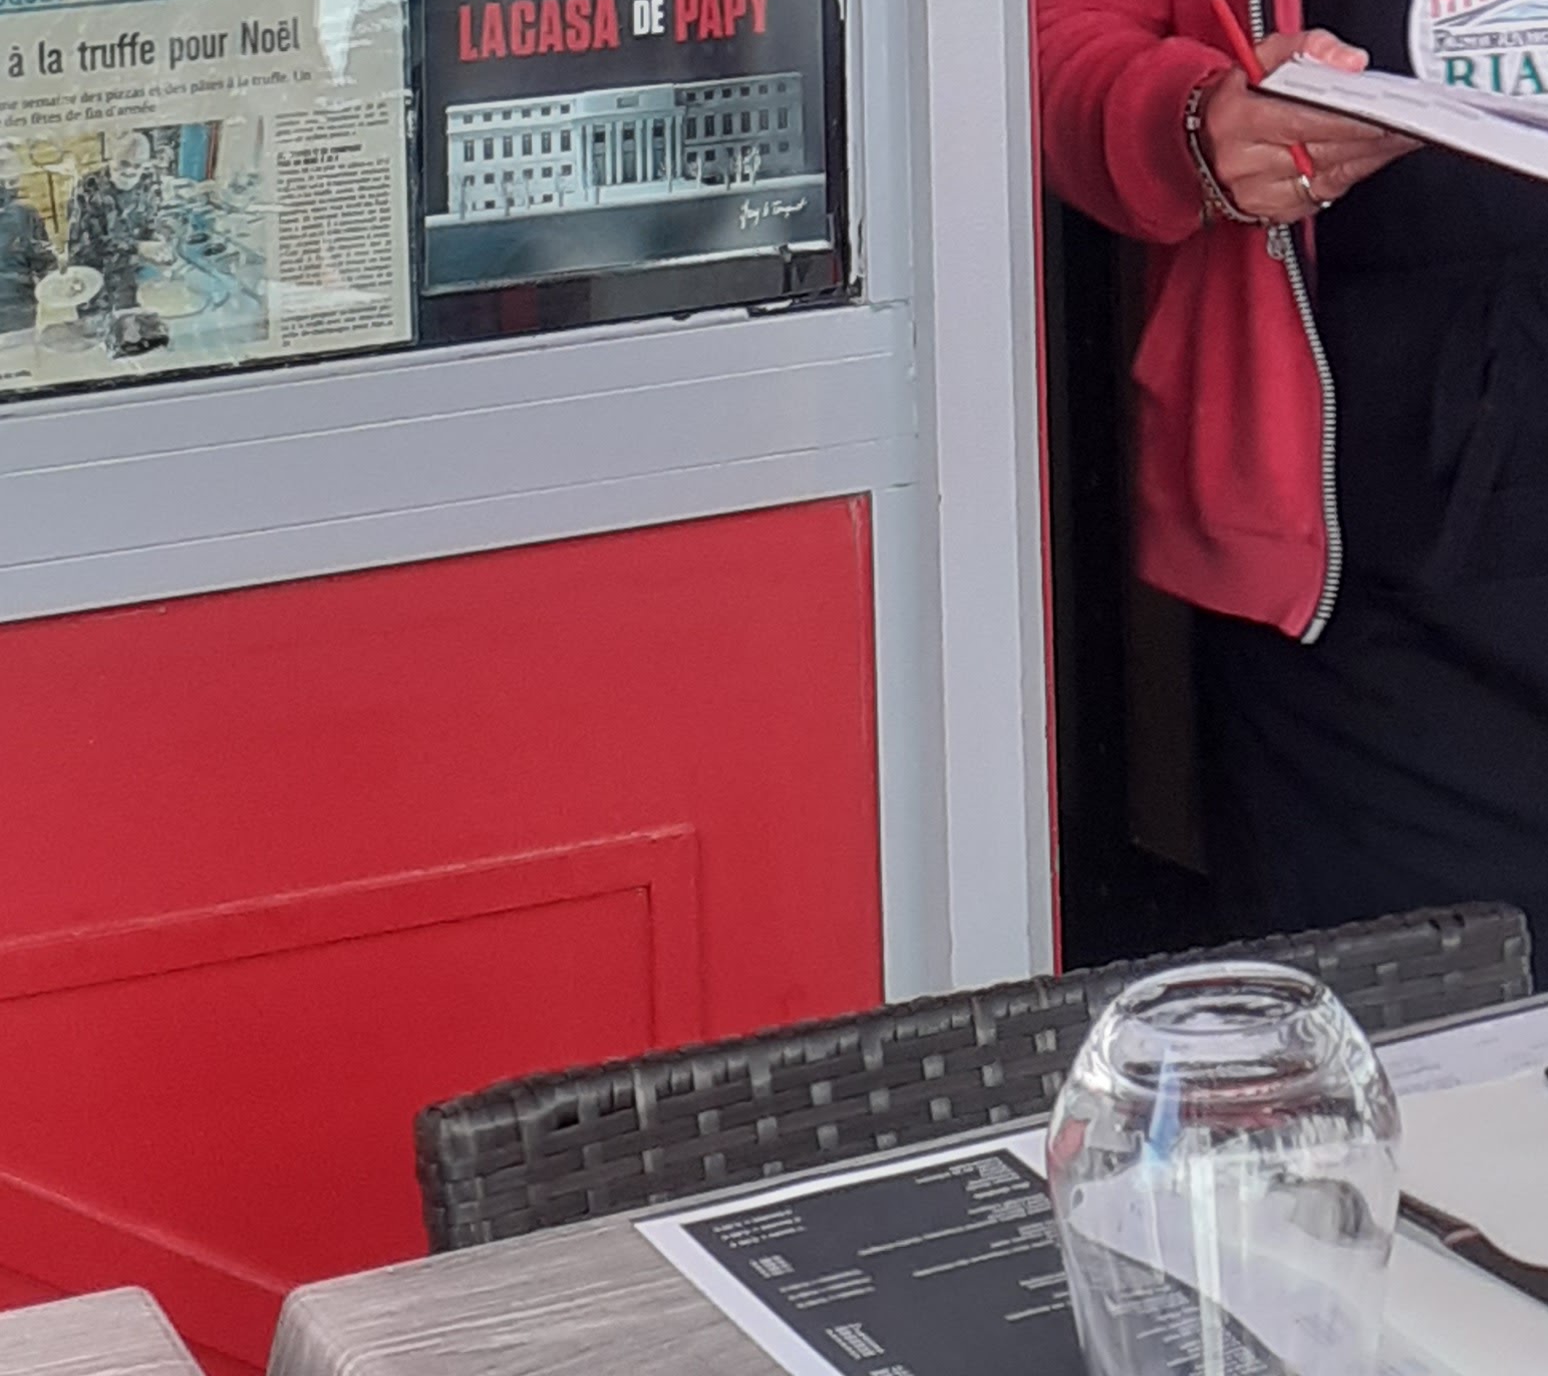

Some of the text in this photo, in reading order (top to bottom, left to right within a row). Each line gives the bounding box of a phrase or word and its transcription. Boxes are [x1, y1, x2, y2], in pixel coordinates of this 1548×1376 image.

[8, 16, 301, 78] à la truffe pour Noël
